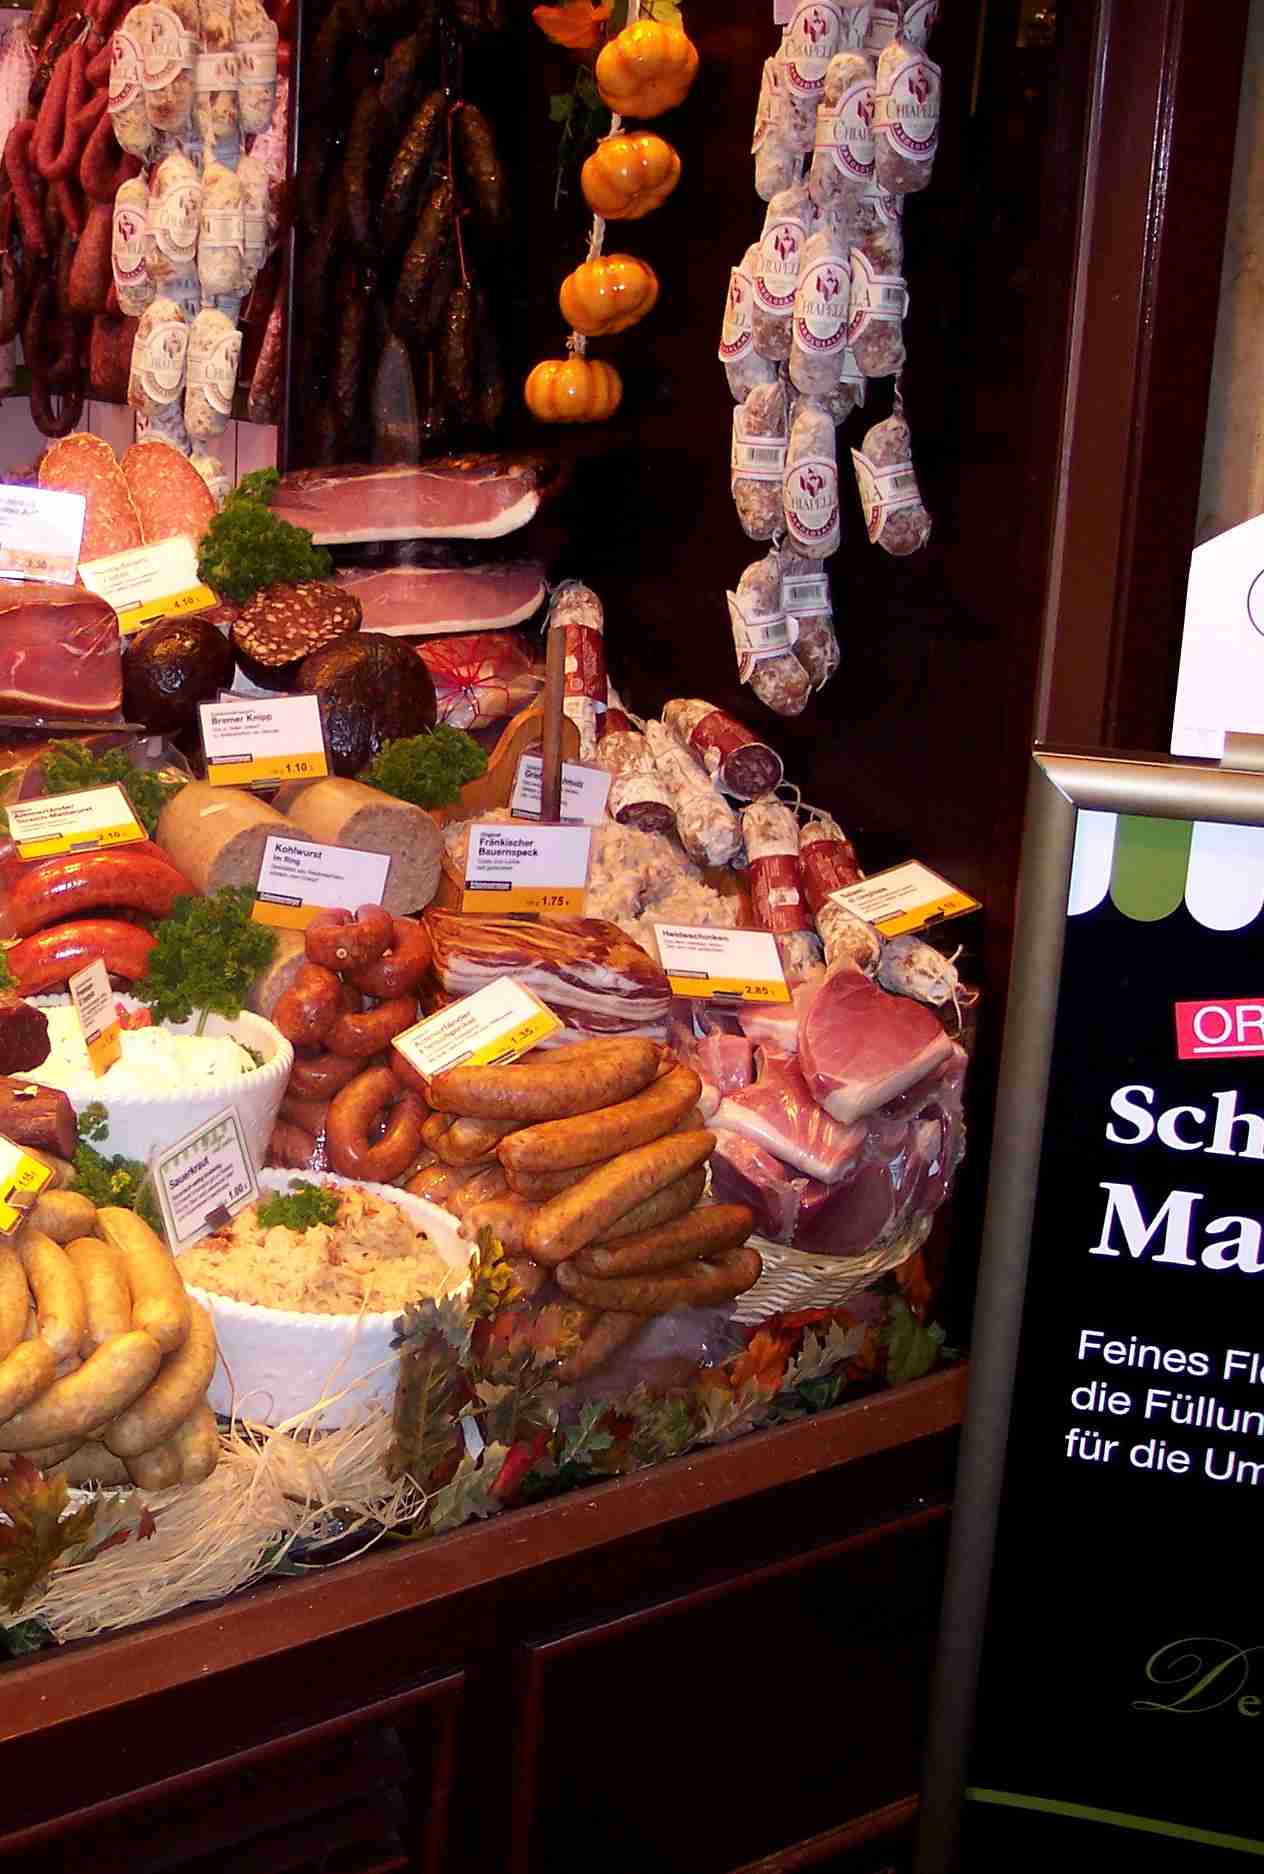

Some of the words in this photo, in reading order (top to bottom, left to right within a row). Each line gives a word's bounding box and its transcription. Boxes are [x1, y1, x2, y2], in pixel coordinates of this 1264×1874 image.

[275, 844, 323, 860] Kohlwurst
[478, 847, 538, 857] Bauernspeck
[479, 838, 534, 848] Fränkischer
[542, 895, 564, 906] 1.75
[1193, 1004, 1264, 1044] OR
[1105, 1085, 1264, 1159] Sch
[1089, 1181, 1264, 1273] Ma
[1078, 1330, 1209, 1376] Feines
[1224, 1349, 1264, 1385] Fl
[1071, 1381, 1131, 1415] die
[1144, 1388, 1264, 1436] Füllun
[1065, 1428, 1120, 1462] für
[1129, 1439, 1190, 1473] die
[1204, 1447, 1264, 1485] Um
